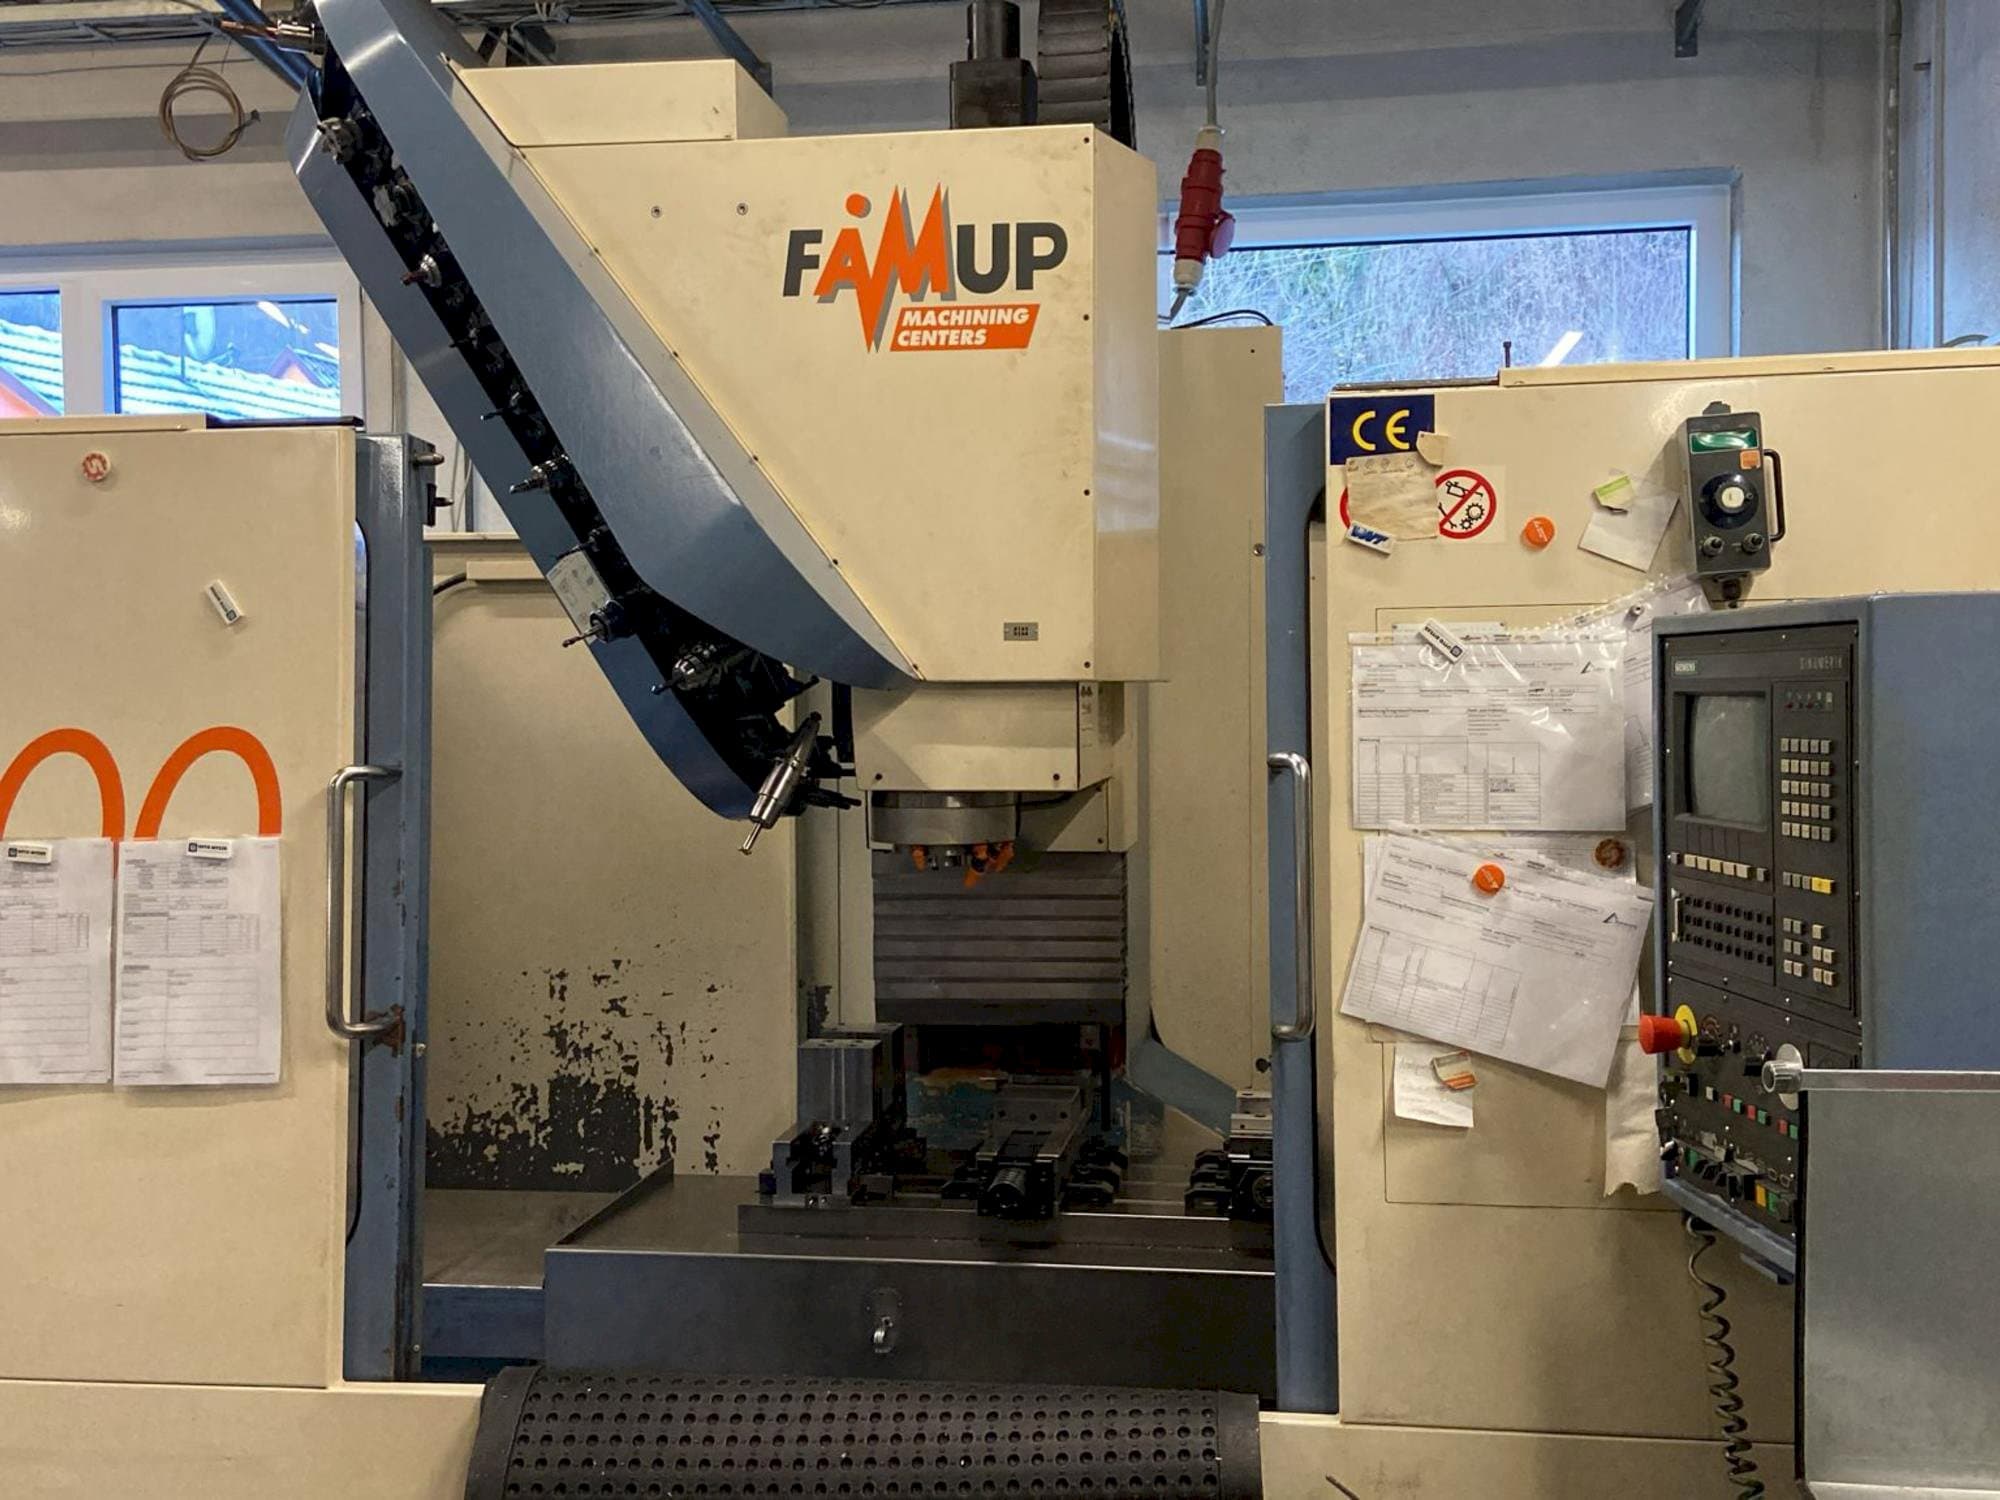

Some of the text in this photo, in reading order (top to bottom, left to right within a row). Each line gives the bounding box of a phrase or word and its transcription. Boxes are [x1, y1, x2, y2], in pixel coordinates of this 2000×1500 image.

[783, 182, 1068, 353] FAMUP
[902, 307, 1030, 326] MACHINING
[897, 328, 987, 347] CENTERS
[1352, 409, 1410, 451] CE
